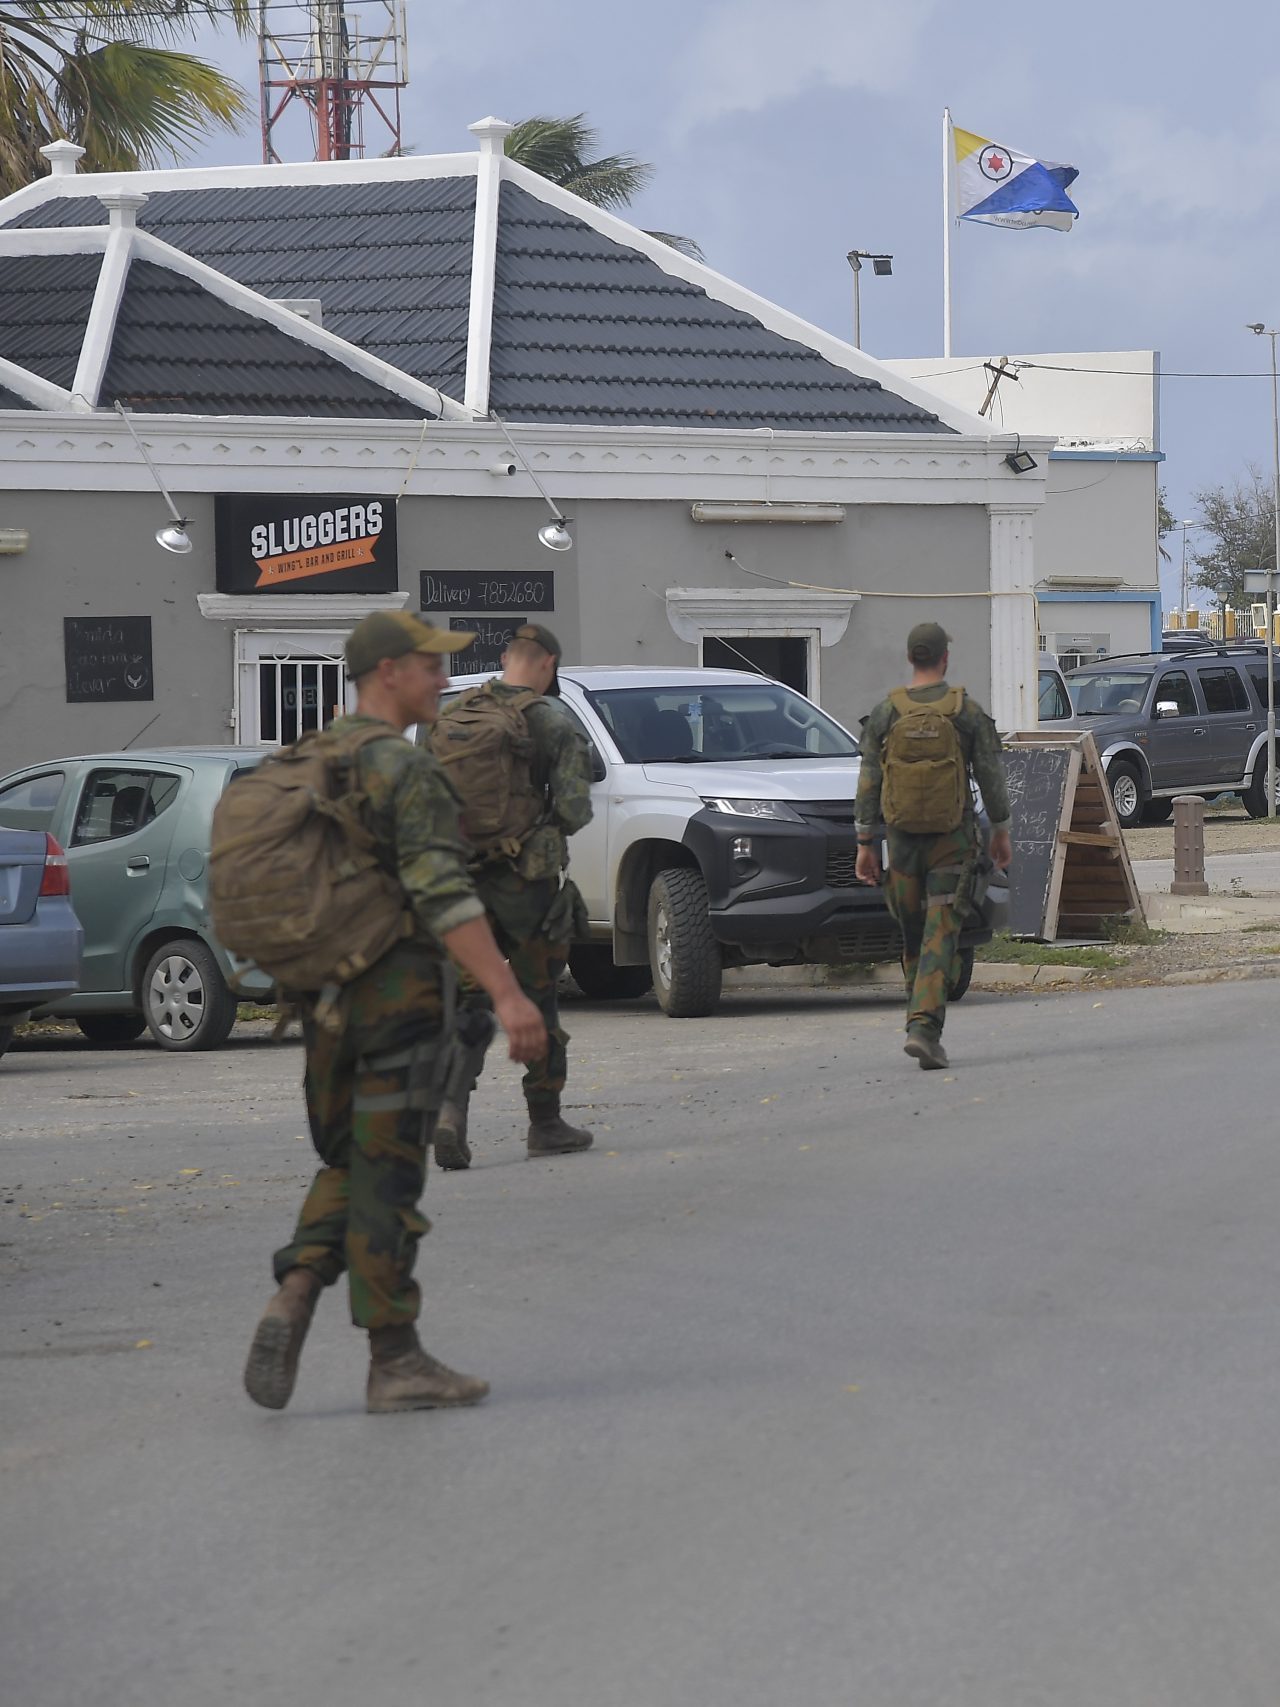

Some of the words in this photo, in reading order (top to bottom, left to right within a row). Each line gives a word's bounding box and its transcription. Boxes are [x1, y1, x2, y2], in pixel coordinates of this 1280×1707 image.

[251, 502, 382, 558] SLUGGERS
[306, 556, 319, 568] BAR
[321, 552, 334, 564] AND
[336, 548, 355, 561] GRILL
[422, 575, 471, 605] Delivery
